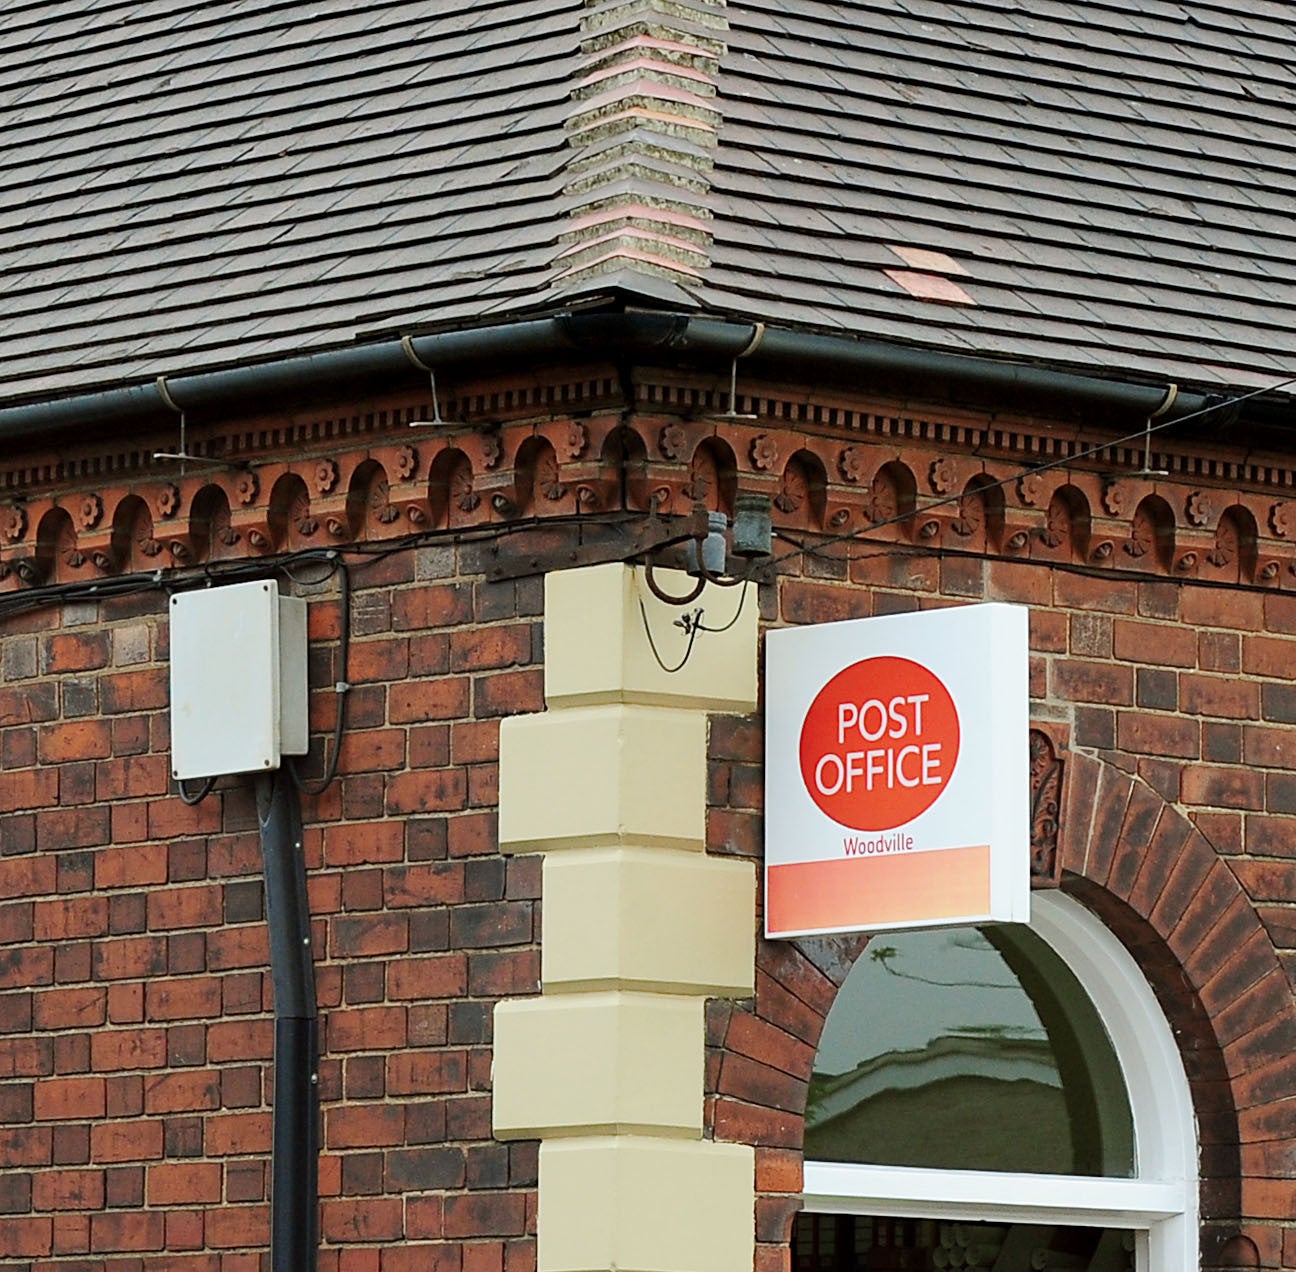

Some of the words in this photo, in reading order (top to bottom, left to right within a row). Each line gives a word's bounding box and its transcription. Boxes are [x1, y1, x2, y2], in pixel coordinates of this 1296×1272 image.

[838, 694, 929, 744] POST
[815, 743, 942, 795] OFFICE
[843, 833, 914, 856] Woodville
